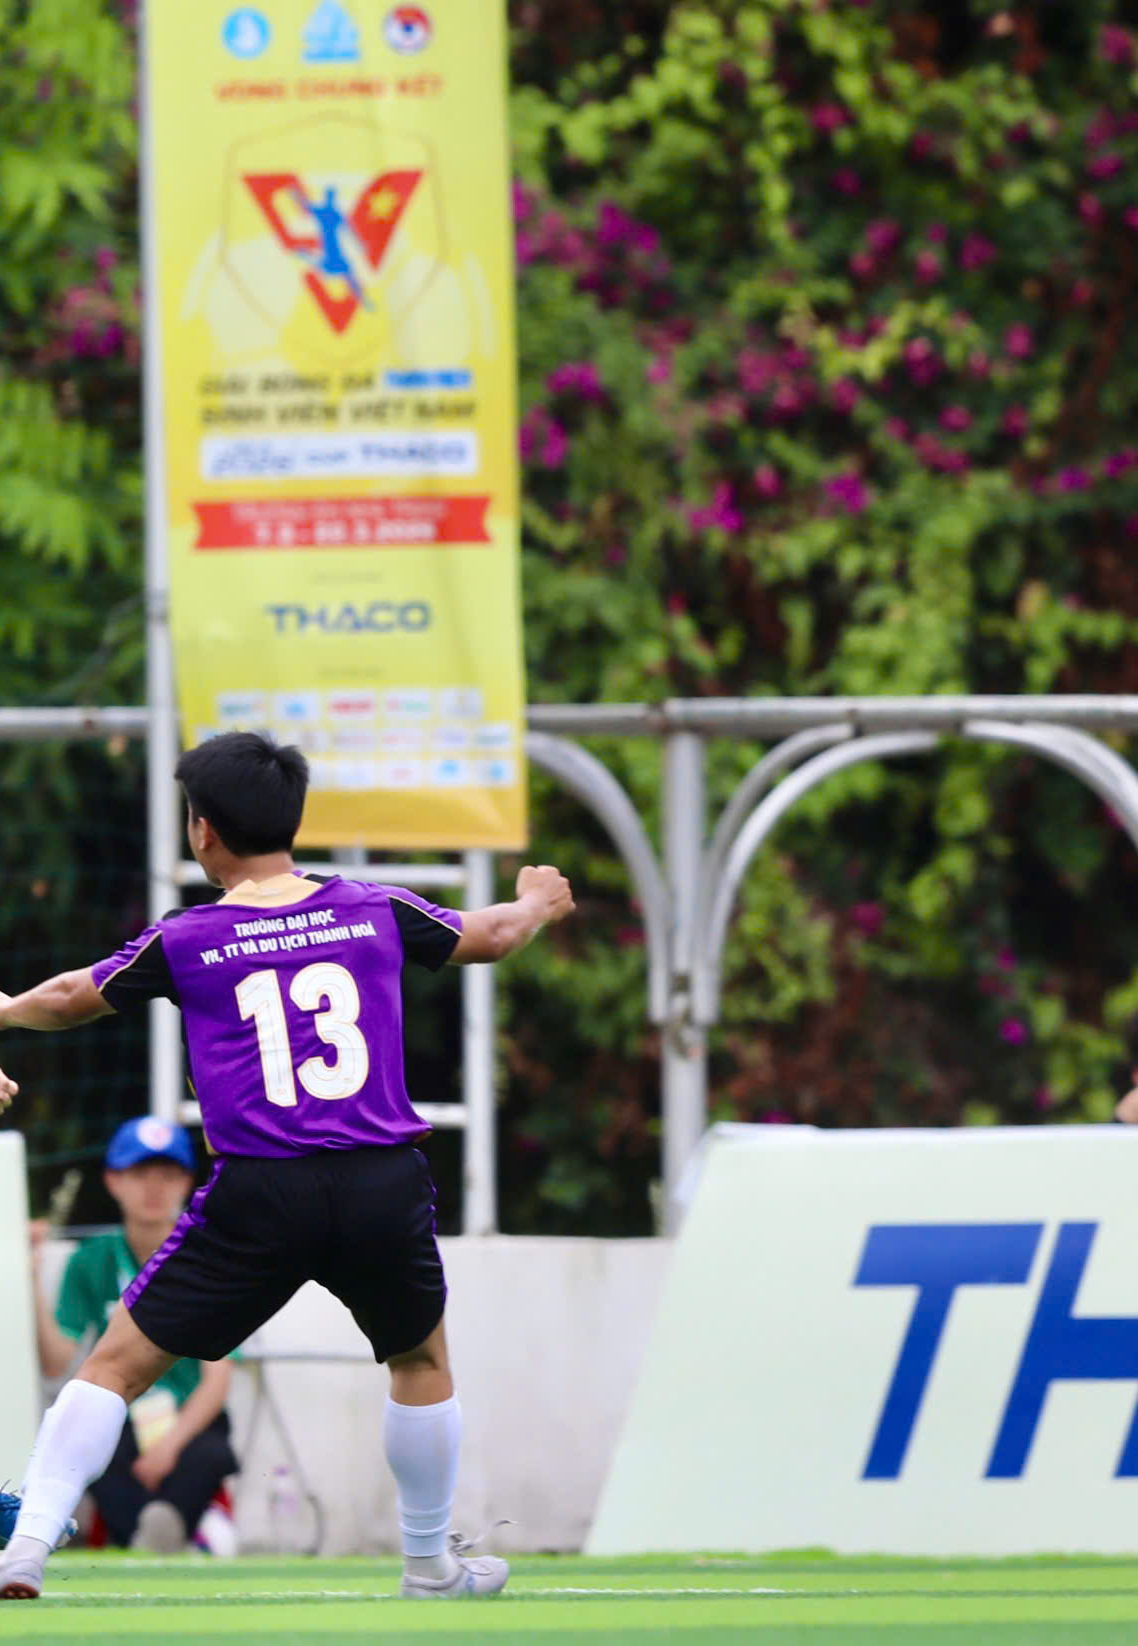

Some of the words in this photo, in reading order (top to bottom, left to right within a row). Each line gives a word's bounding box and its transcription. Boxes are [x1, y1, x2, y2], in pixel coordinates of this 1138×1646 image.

[267, 602, 431, 633] THACO
[308, 909, 337, 926] HỌC
[307, 926, 351, 945] THANH
[234, 962, 370, 1107] 13
[851, 1221, 1138, 1480] TH
